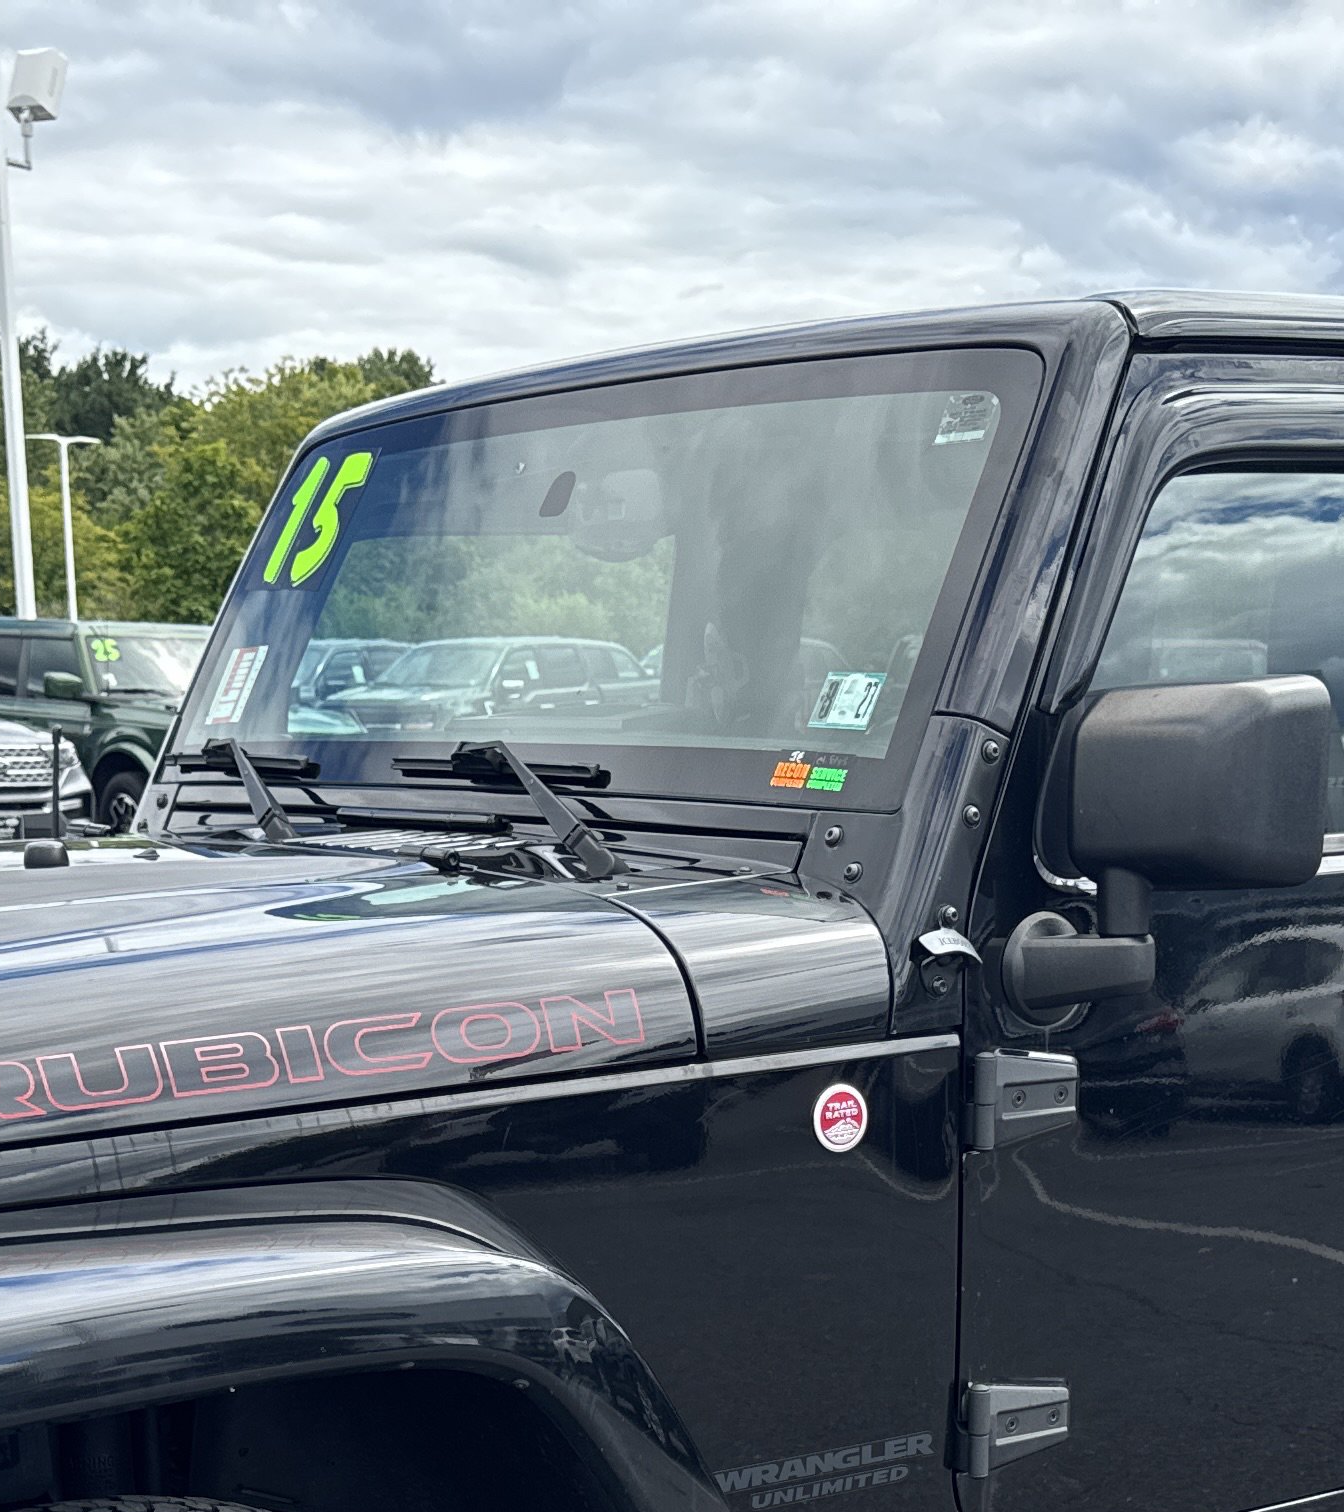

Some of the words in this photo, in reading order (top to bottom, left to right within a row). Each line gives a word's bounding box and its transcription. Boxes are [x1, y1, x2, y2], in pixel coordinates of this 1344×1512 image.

[263, 452, 373, 588] 15
[91, 638, 120, 662] 25
[825, 1108, 858, 1120] RATED
[827, 1100, 857, 1111] TRAIL
[714, 1433, 934, 1493] WRANGLER
[751, 1466, 909, 1509] UNLIMITED
